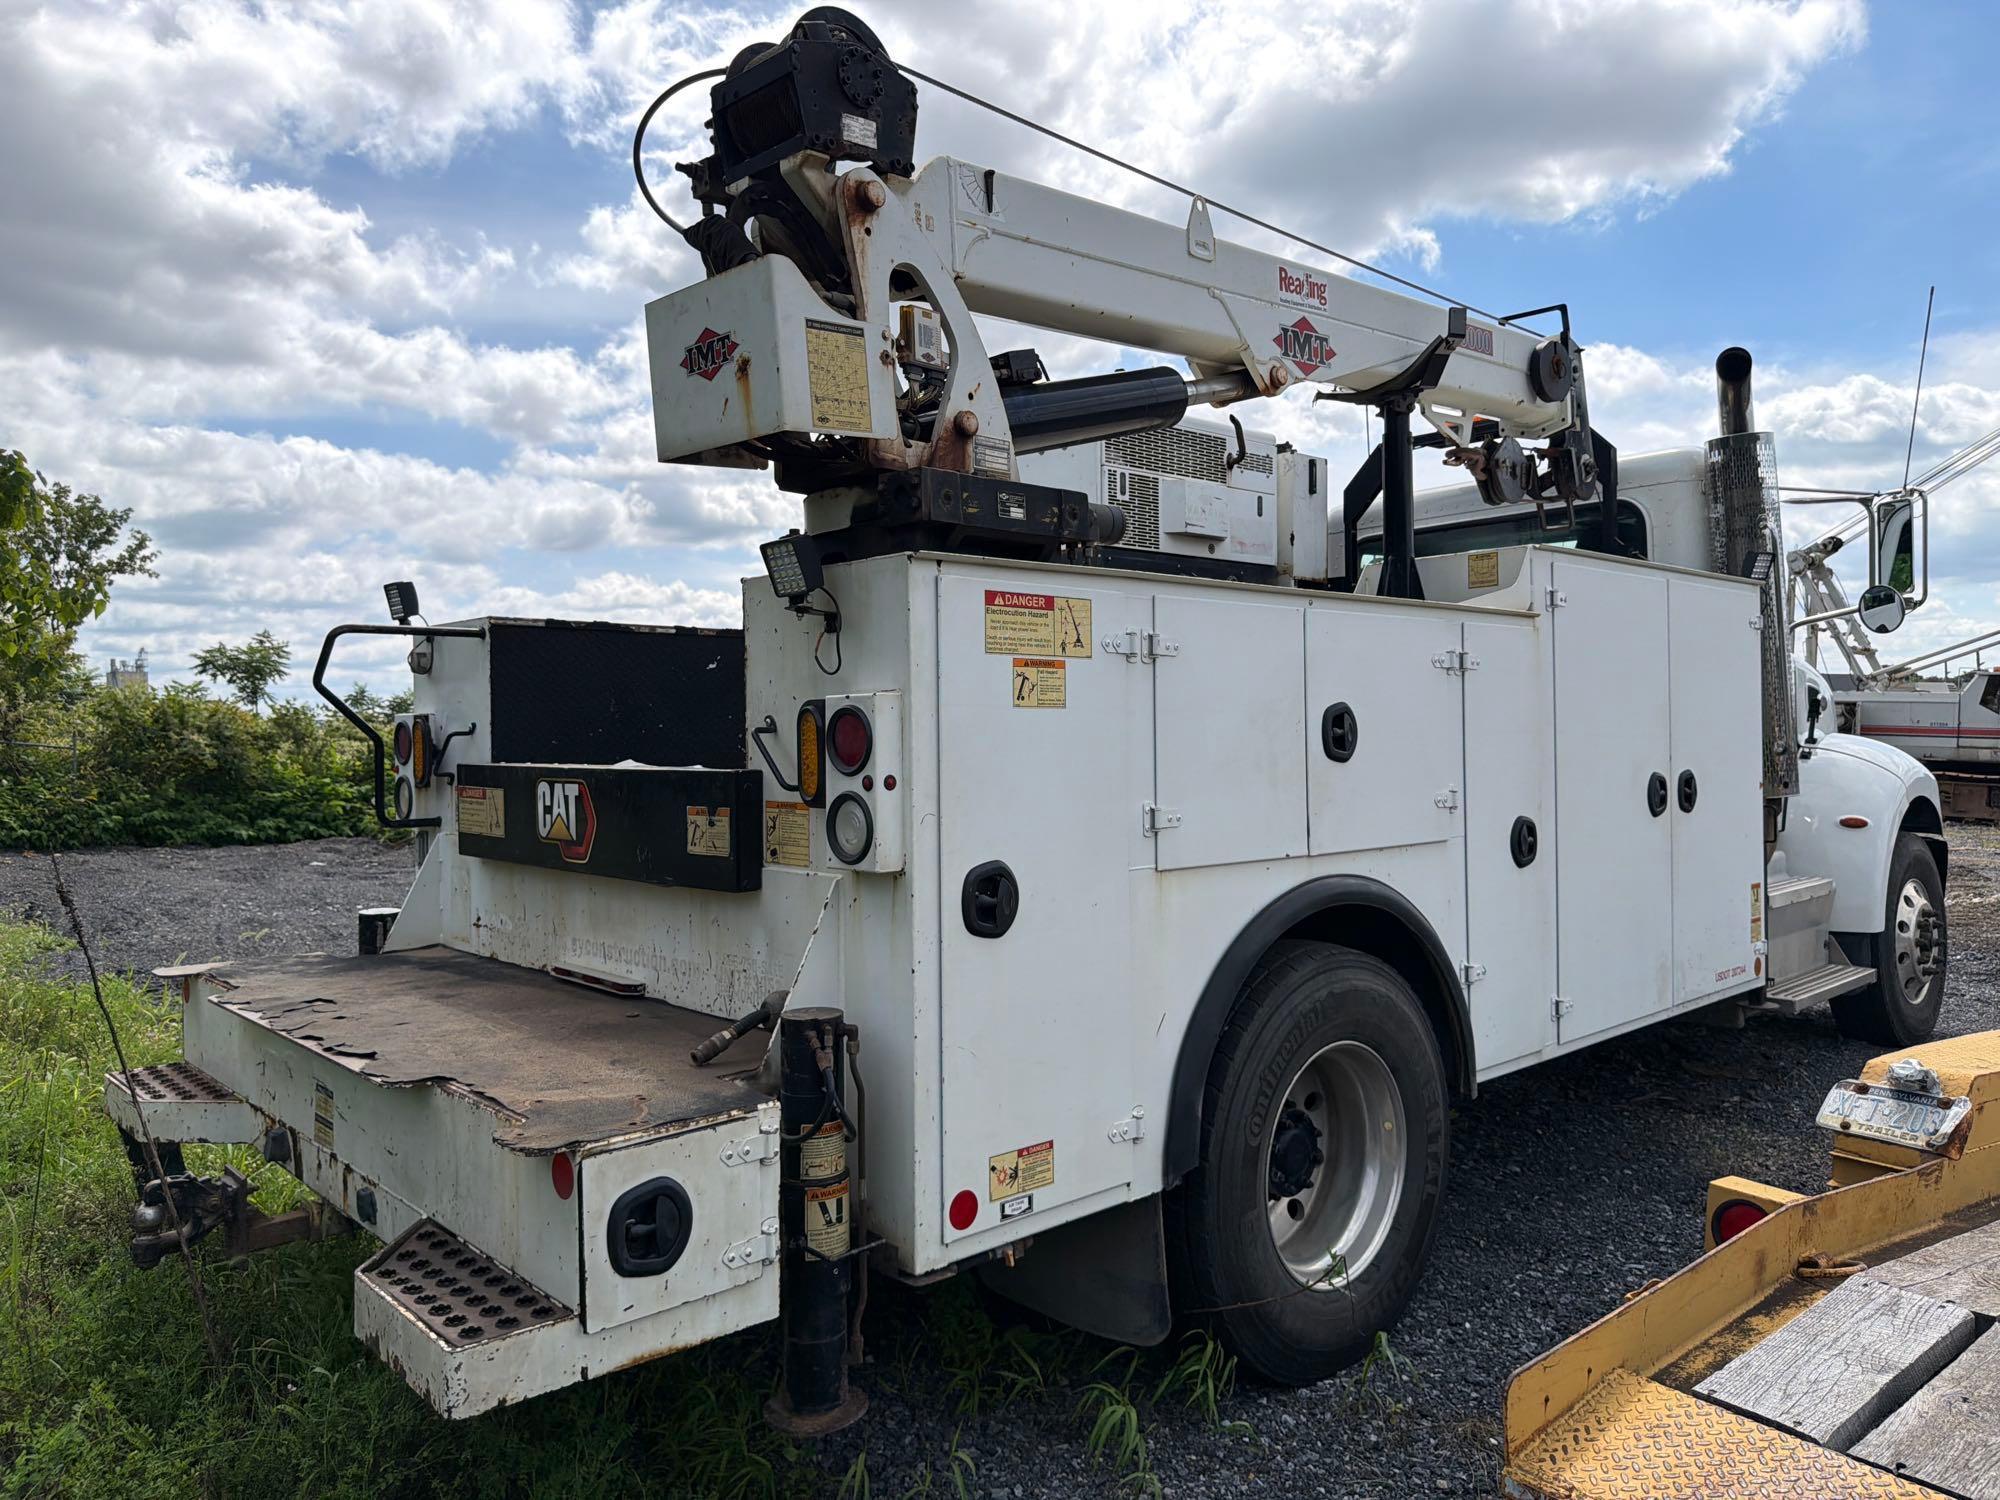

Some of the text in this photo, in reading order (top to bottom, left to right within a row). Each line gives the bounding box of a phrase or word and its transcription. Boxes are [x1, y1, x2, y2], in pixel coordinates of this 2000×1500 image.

[686, 332, 731, 376] IMT
[1280, 323, 1331, 367] IMT
[1005, 594, 1046, 608] DANGER
[986, 606, 1049, 619] Electrocution Hazard
[1029, 660, 1056, 668] WARNING
[537, 780, 579, 841] CAT
[1867, 1087, 1938, 1106] PENNSYLVANIA
[1857, 1122, 1920, 1143] TRAILER
[1028, 1142, 1050, 1154] DANGER
